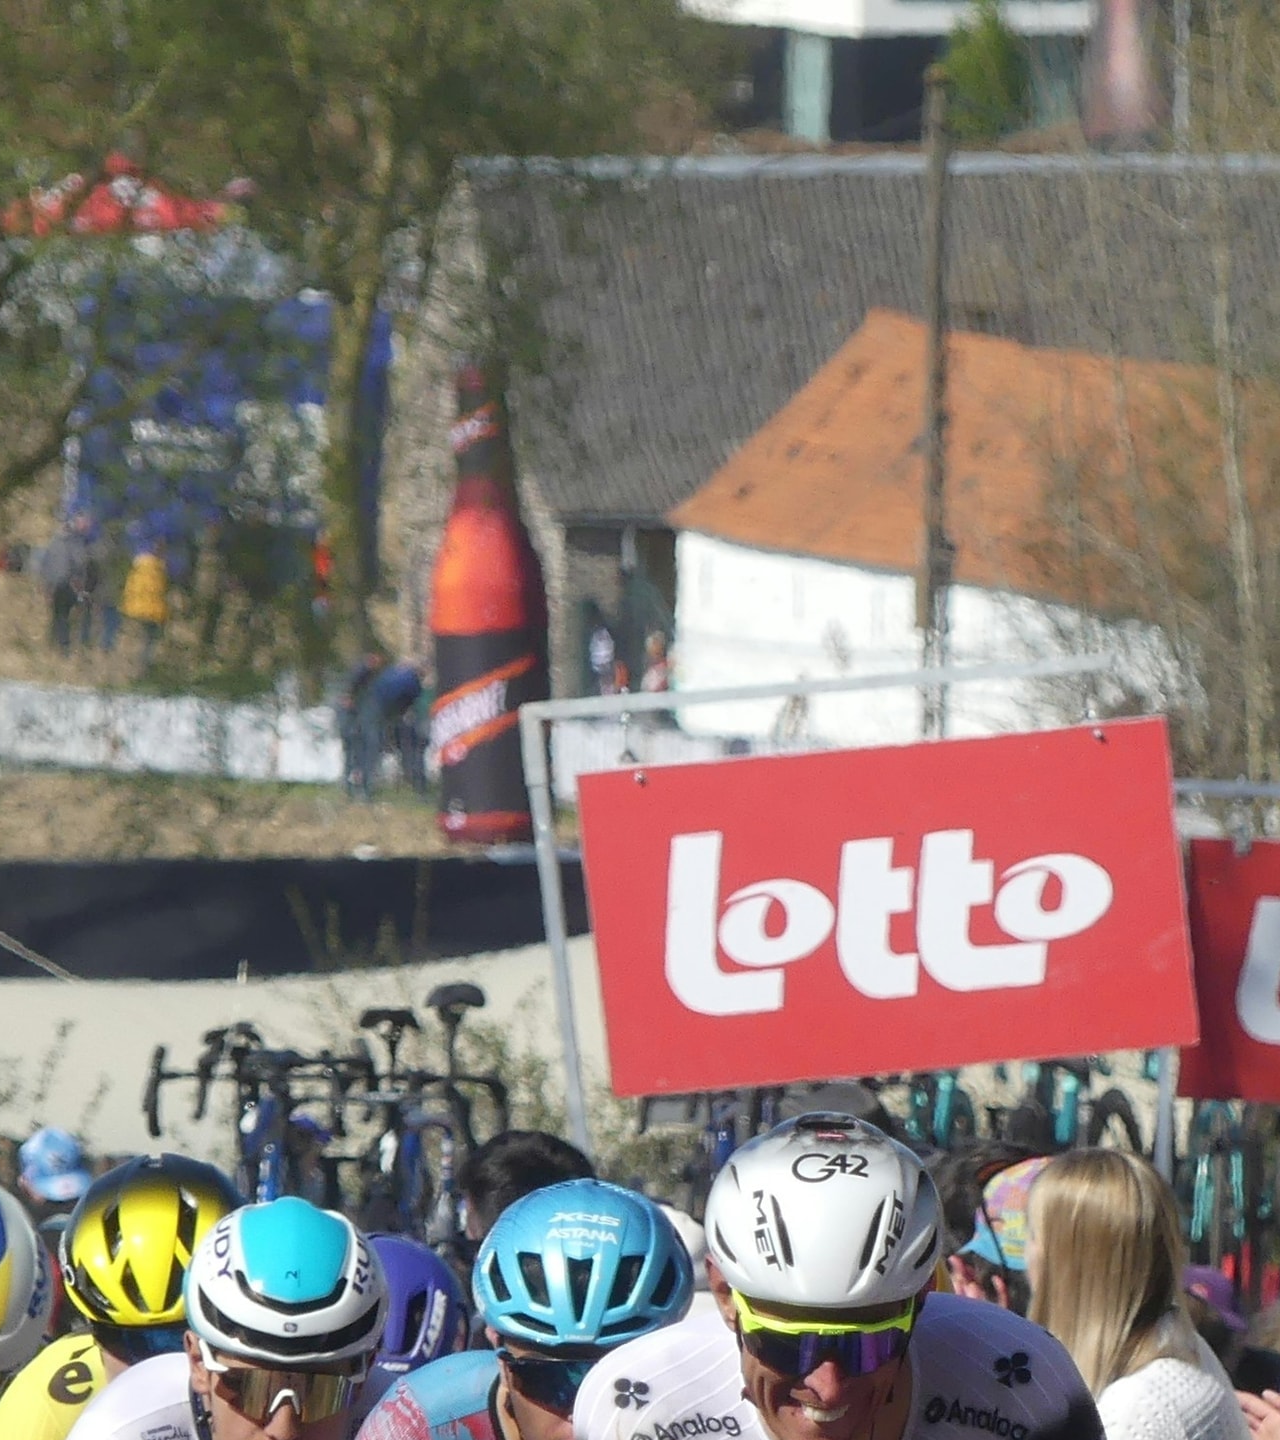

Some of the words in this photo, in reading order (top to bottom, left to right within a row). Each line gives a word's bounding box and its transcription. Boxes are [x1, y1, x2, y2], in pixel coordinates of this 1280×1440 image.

[665, 829, 1114, 1016] lotto
[792, 1152, 870, 1183] G42
[546, 1227, 618, 1245] ASTANA
[752, 1189, 783, 1272] MET
